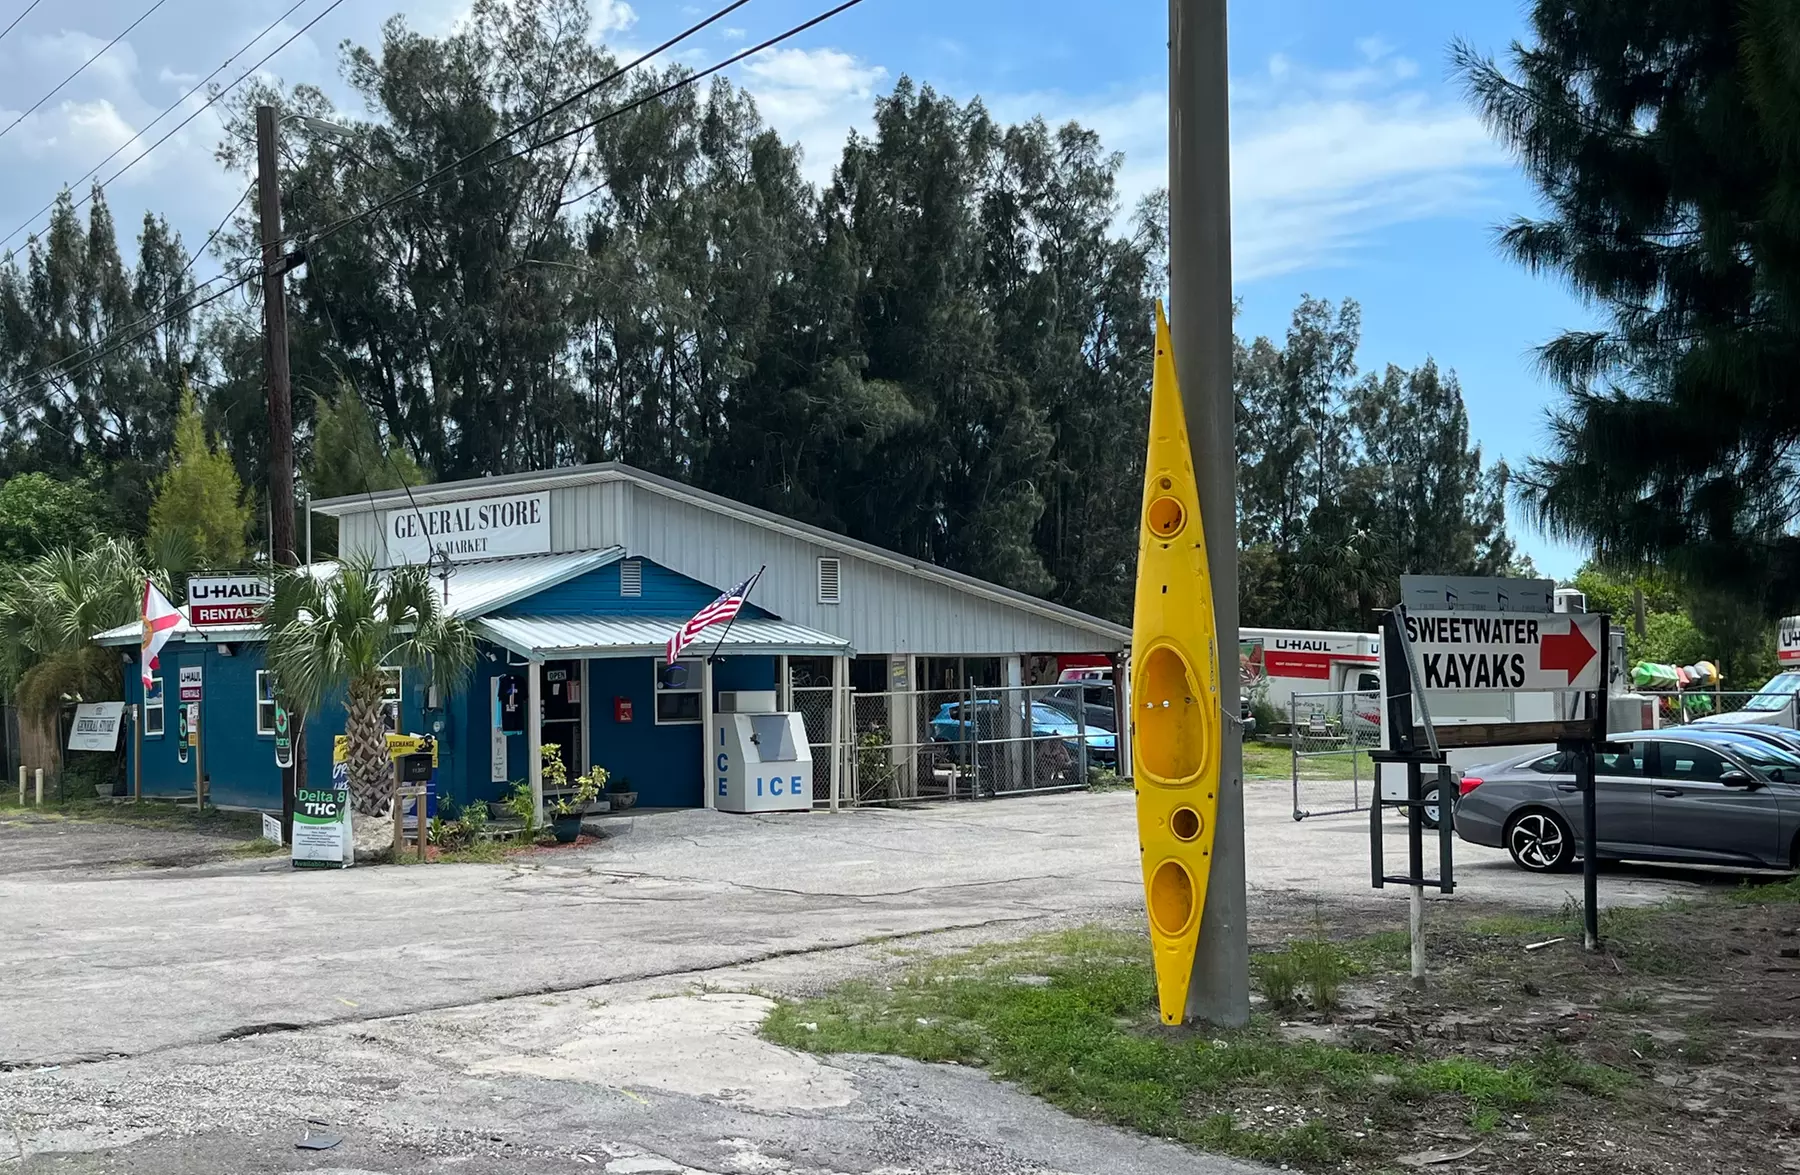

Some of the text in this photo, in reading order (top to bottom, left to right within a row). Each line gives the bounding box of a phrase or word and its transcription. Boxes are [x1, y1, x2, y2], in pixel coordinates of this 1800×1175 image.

[394, 498, 542, 540] GENERAL STORE
[445, 537, 489, 556] MARKET
[192, 583, 270, 599] U-HAUL
[200, 608, 266, 621] RENTALS
[1406, 616, 1539, 644] SWEETWATER
[1275, 639, 1332, 652] U-HAUL
[181, 671, 202, 682] U-HAUL
[549, 671, 566, 680] OPEN
[1422, 652, 1526, 689] KAYAKS
[717, 727, 729, 796] ICE
[757, 775, 802, 797] ICE
[298, 789, 346, 803] Delta 8
[304, 802, 337, 816] THC
